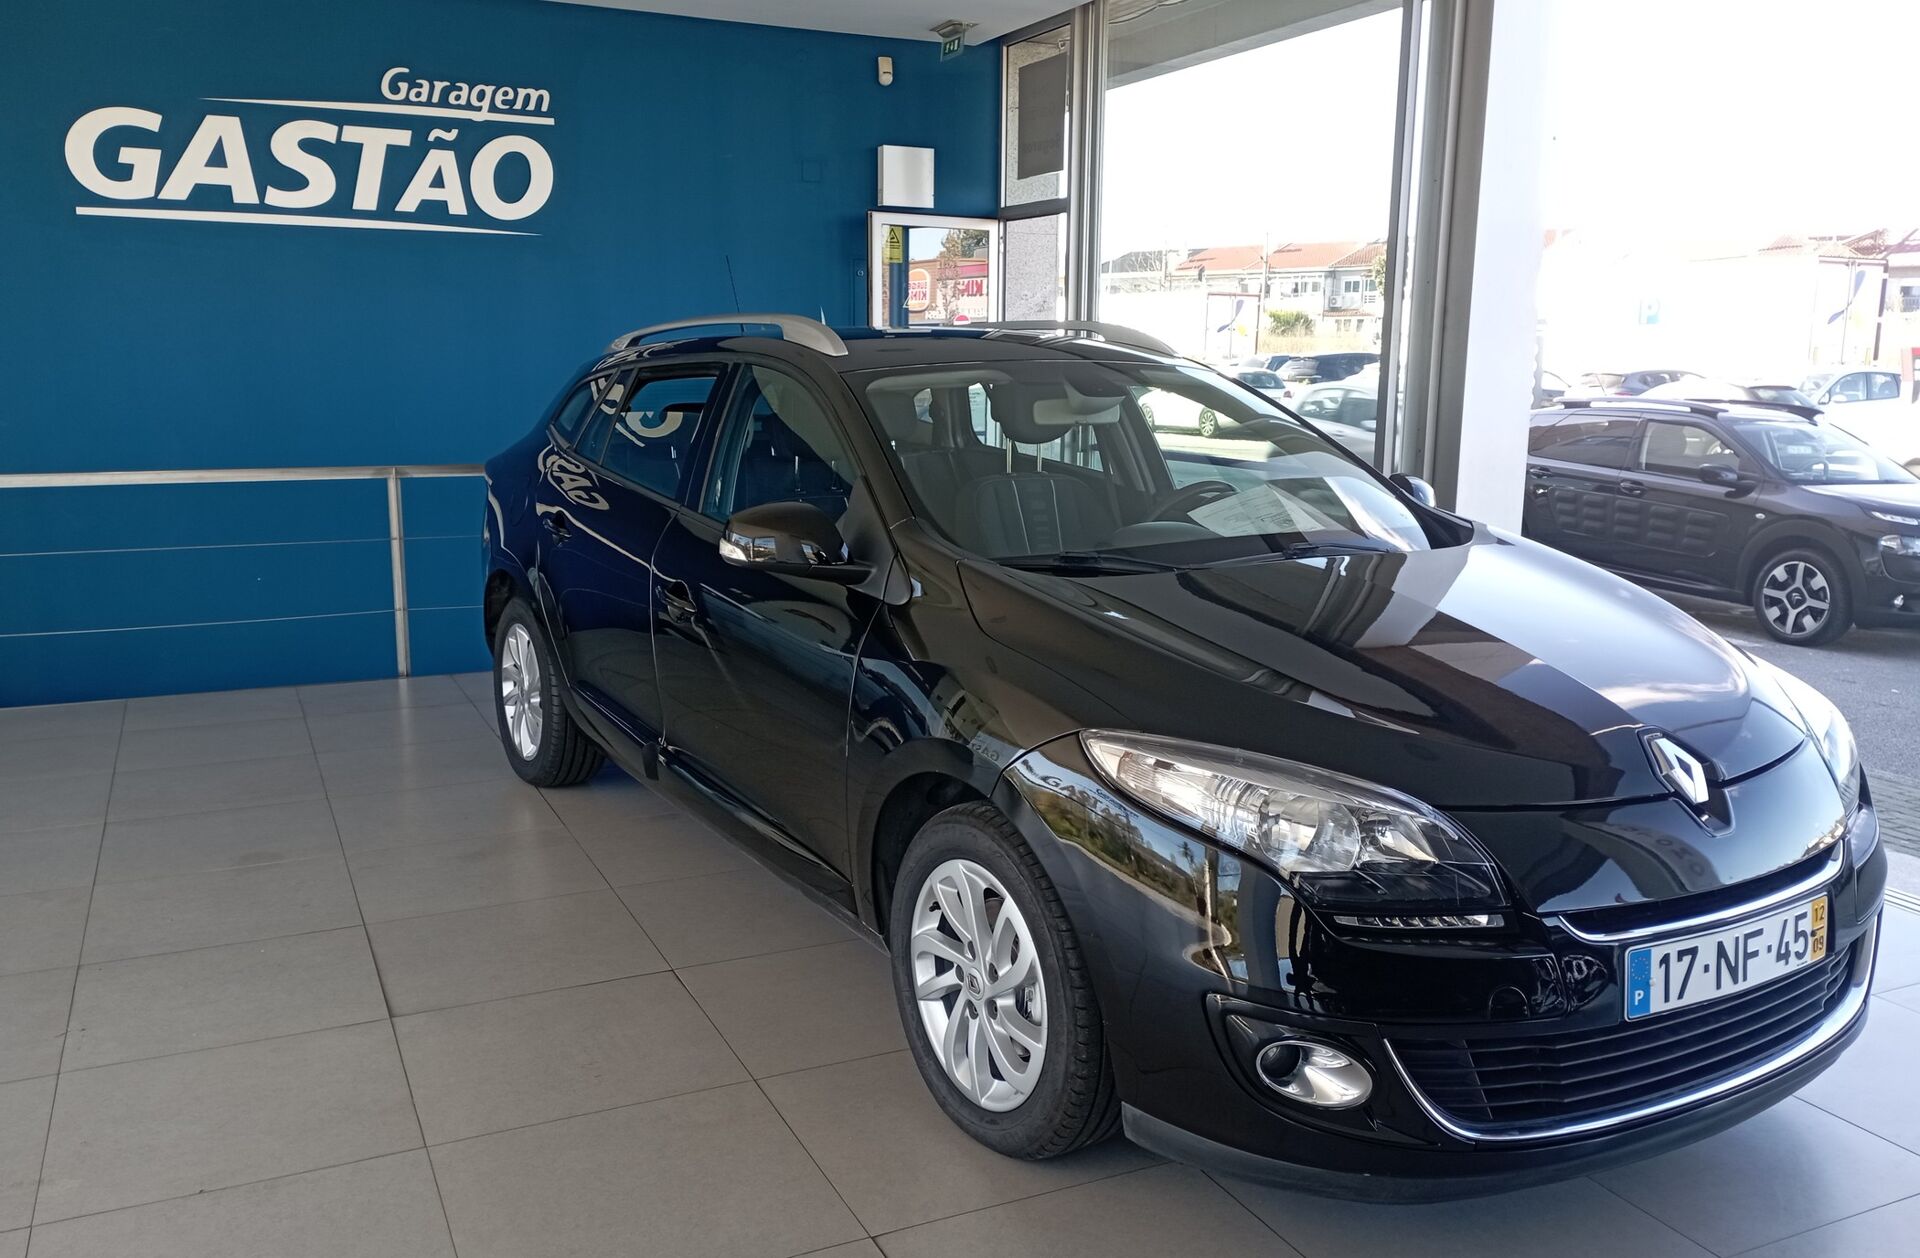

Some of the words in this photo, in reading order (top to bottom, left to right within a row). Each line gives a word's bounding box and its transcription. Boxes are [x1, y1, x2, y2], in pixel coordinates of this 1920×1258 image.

[380, 66, 551, 122] Garagem
[64, 106, 554, 221] GASTÃO
[1814, 905, 1825, 923] 12
[1813, 935, 1825, 954] 09
[1634, 989, 1645, 1006] P
